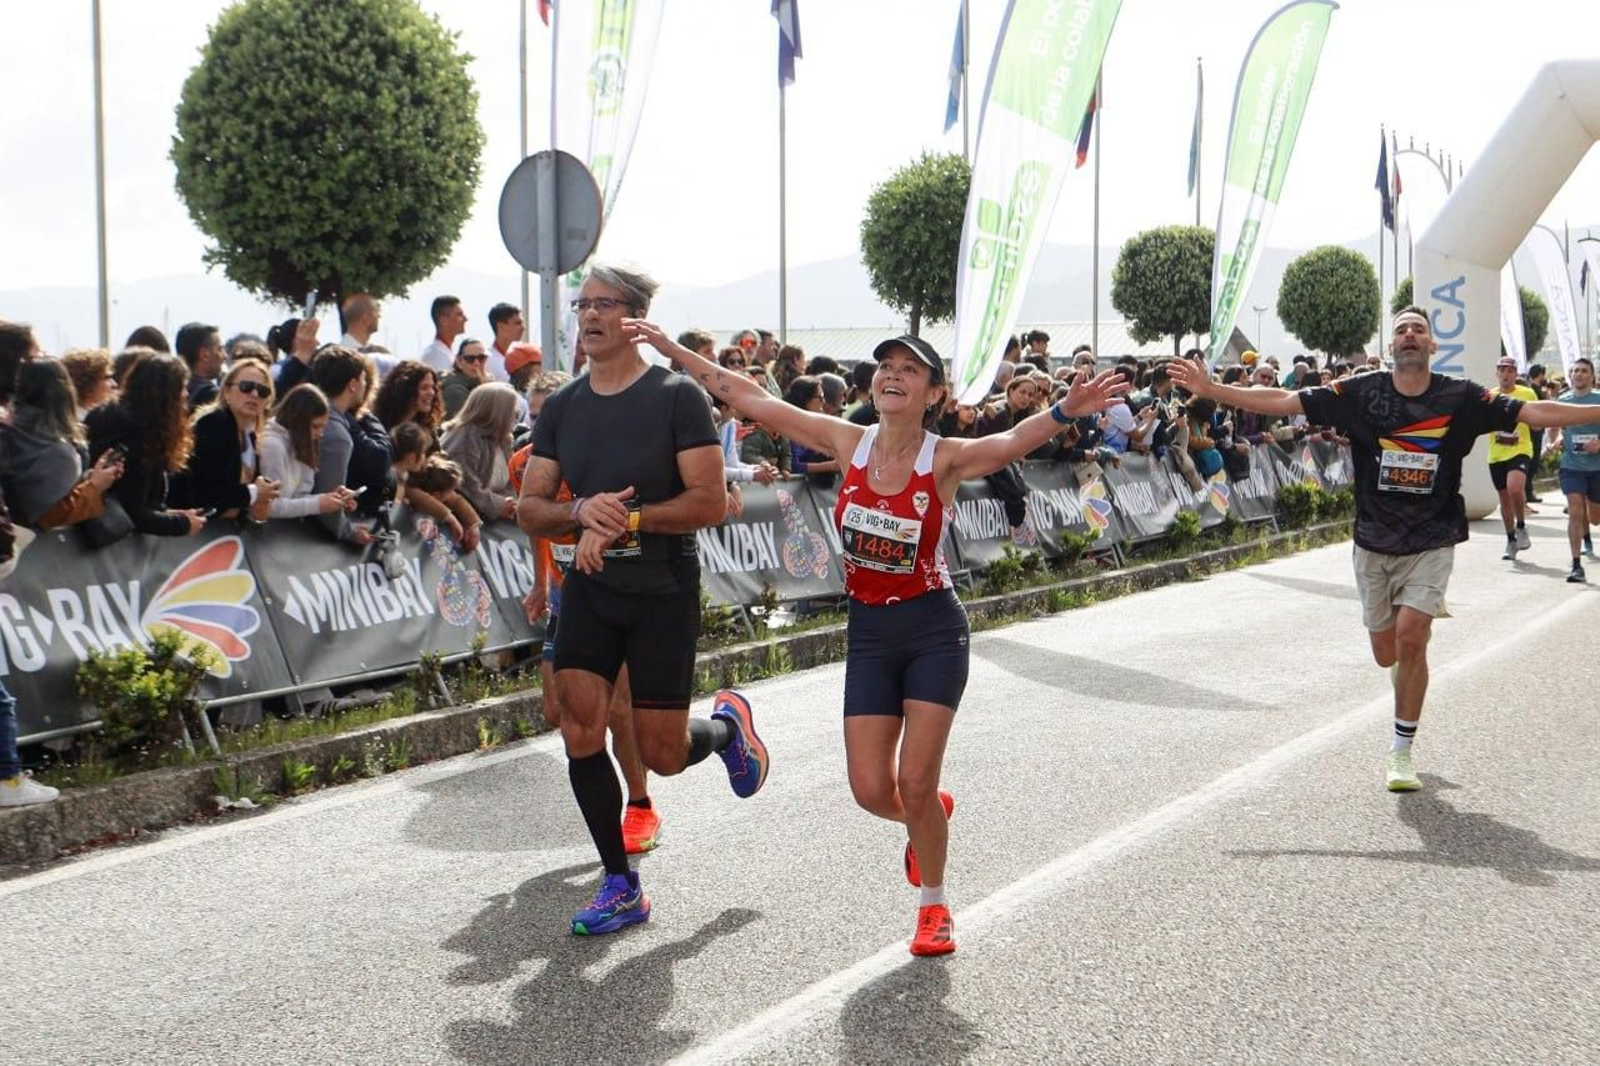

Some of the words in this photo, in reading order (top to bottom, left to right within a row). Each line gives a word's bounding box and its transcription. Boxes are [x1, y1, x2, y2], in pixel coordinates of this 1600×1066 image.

[1049, 65, 1071, 88] la
[1431, 275, 1465, 372] NCA
[1390, 468, 1428, 484] 4346
[850, 511, 861, 524] 25
[883, 518, 901, 532] BAY
[855, 532, 905, 560] 1484
